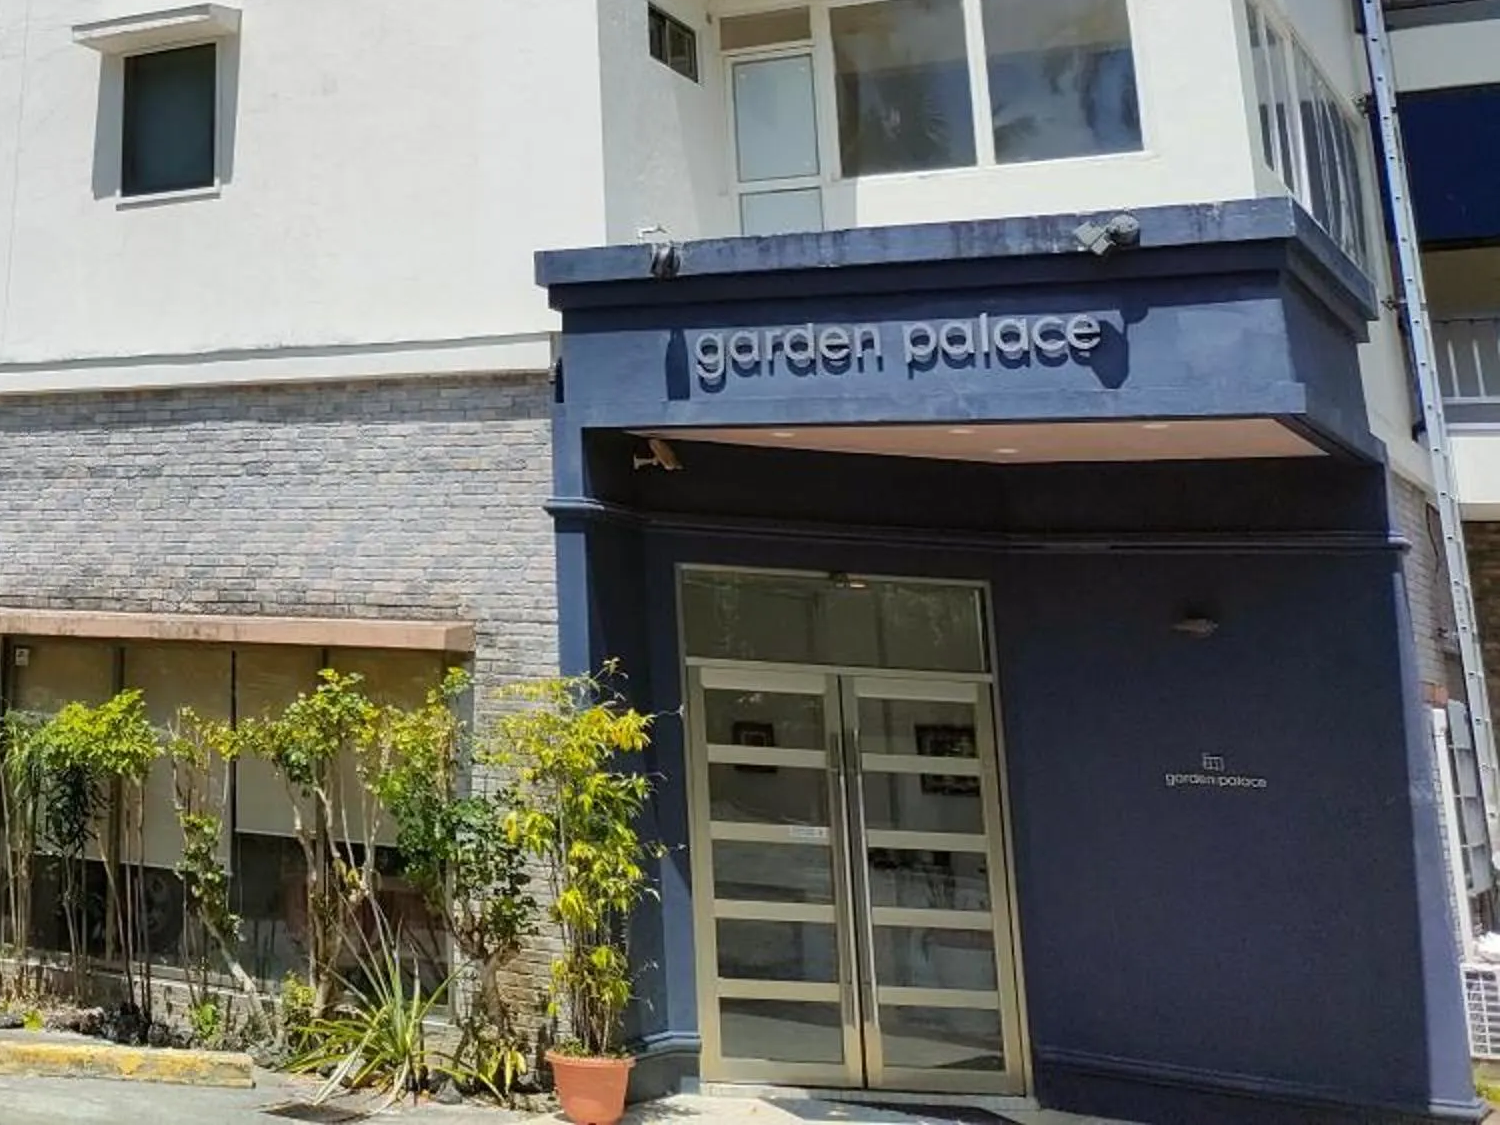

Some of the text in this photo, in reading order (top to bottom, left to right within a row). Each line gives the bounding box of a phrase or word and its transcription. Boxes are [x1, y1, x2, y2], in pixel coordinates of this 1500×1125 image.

[695, 312, 1102, 379] garden palace
[1165, 773, 1267, 788] garden palace
